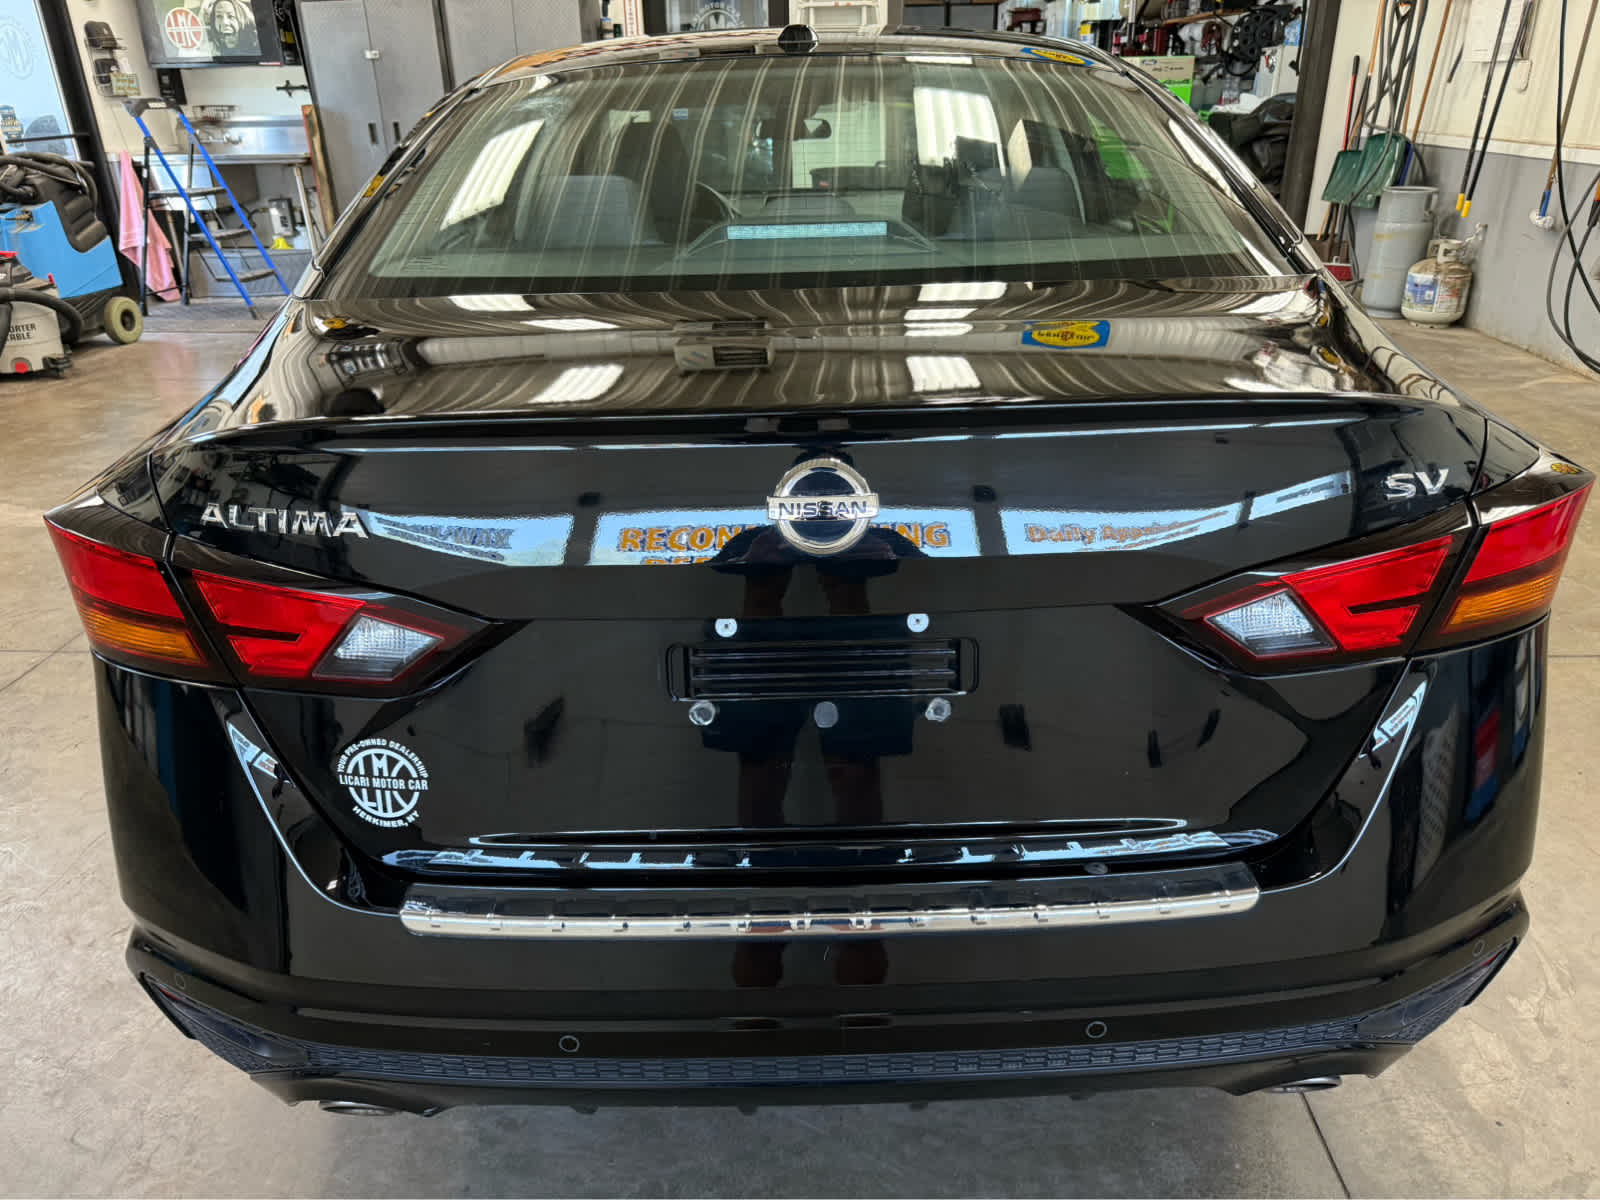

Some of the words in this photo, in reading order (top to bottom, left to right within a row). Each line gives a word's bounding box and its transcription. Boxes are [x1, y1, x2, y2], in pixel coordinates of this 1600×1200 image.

[9, 332, 32, 341] ABLE
[1384, 468, 1449, 501] SV
[777, 500, 867, 518] NISSAN
[200, 502, 369, 539] ALTIMA
[1024, 523, 1097, 545] Daily
[345, 738, 387, 756] PRE-OWNED
[389, 741, 429, 778] DEALERSHIP
[339, 774, 370, 787] LICARI
[372, 777, 406, 790] MOTOR
[407, 779, 429, 791] CAR
[352, 805, 408, 828] HERKIMER,
[406, 810, 420, 824] NY
